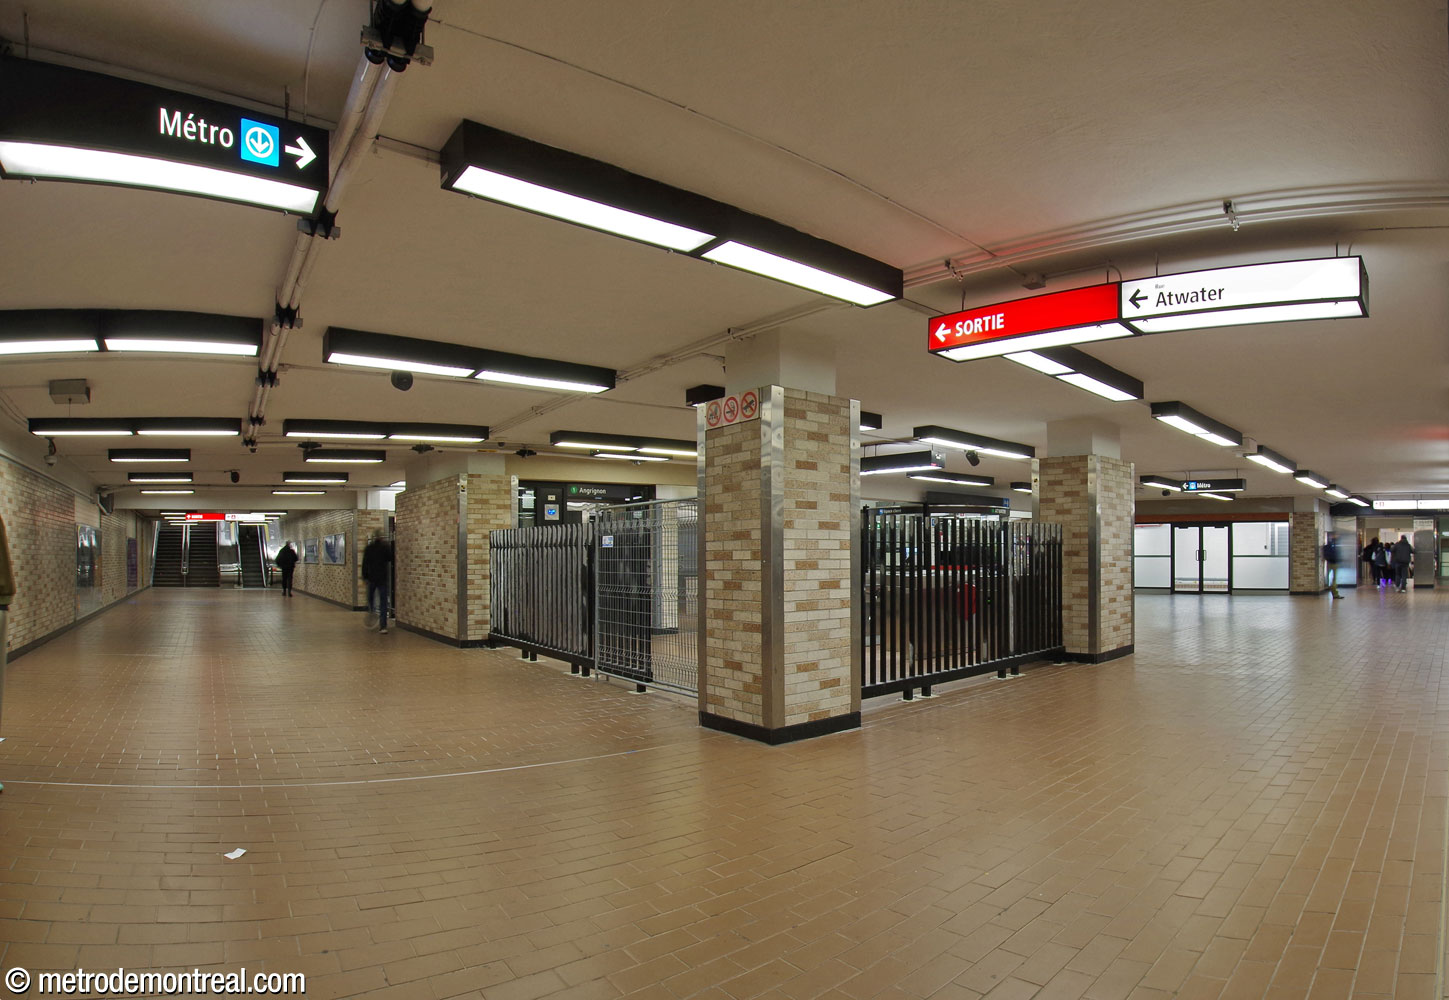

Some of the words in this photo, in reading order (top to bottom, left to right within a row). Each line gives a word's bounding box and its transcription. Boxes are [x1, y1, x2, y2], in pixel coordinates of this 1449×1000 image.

[159, 107, 234, 148] Métro
[1155, 286, 1225, 307] Atwater
[955, 313, 1005, 337] SORTIE
[579, 487, 607, 496] Angrignon
